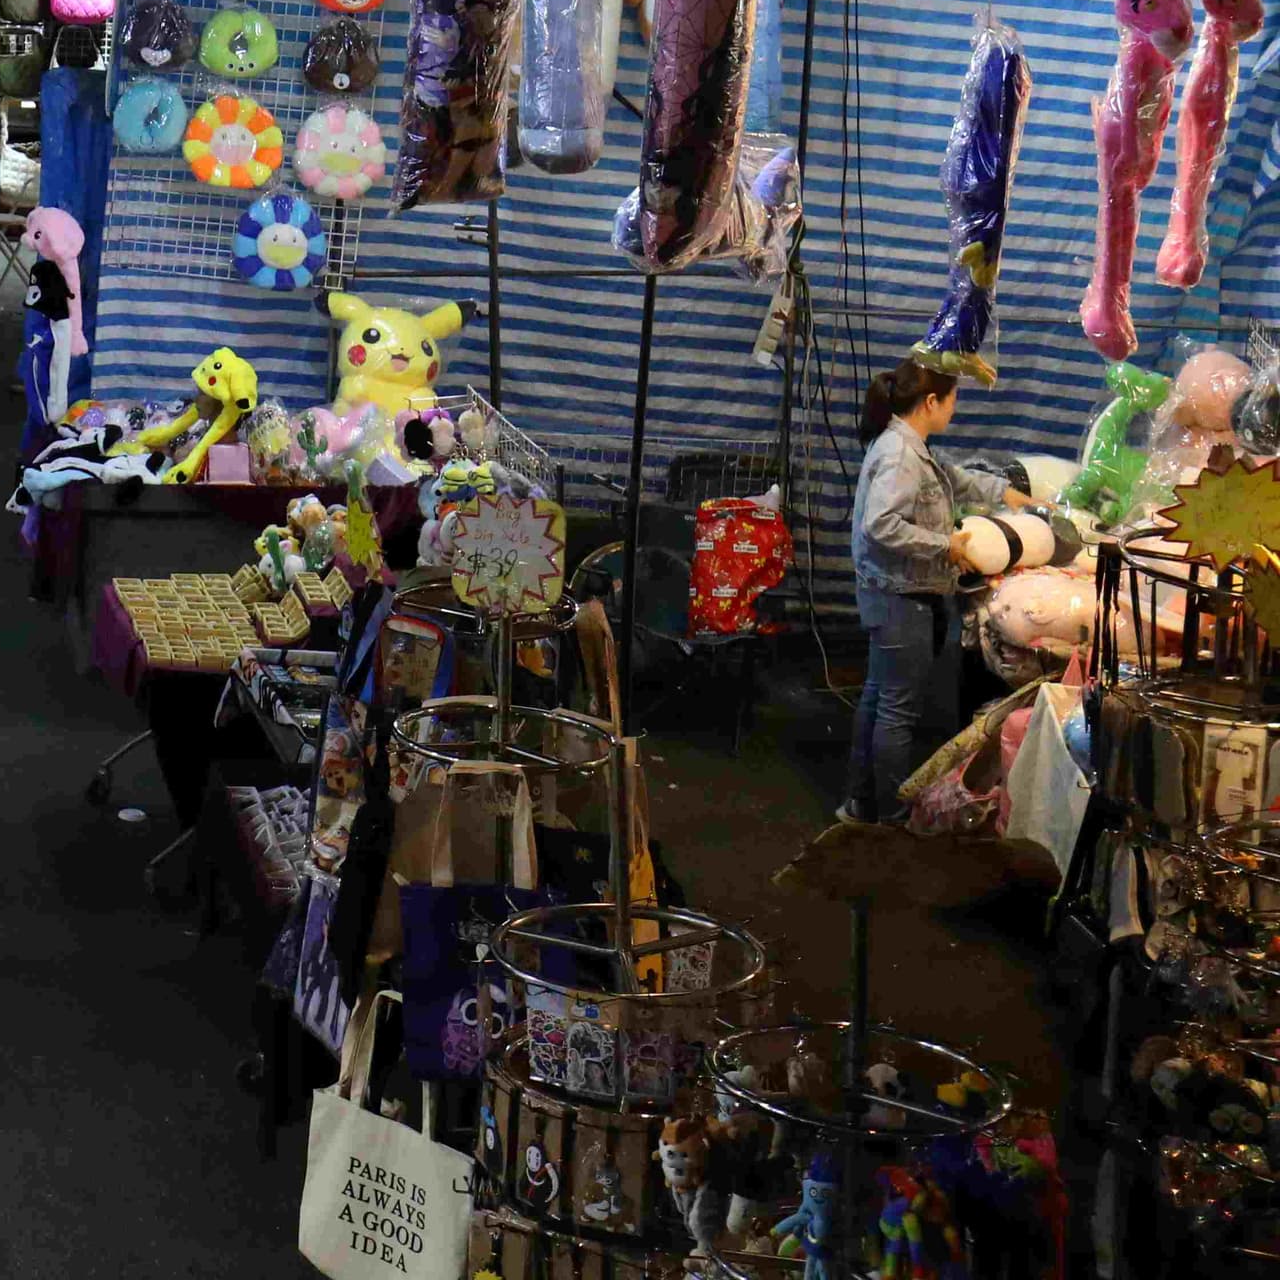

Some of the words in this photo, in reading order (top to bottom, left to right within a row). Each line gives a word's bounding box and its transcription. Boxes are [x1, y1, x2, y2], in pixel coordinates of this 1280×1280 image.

[342, 1179, 426, 1230] ALWAYS
[348, 1157, 406, 1194] PARIS
[410, 1184, 427, 1206] IS
[338, 1203, 355, 1224] A
[362, 1210, 423, 1254] GOOD
[350, 1231, 408, 1273] IDEA
